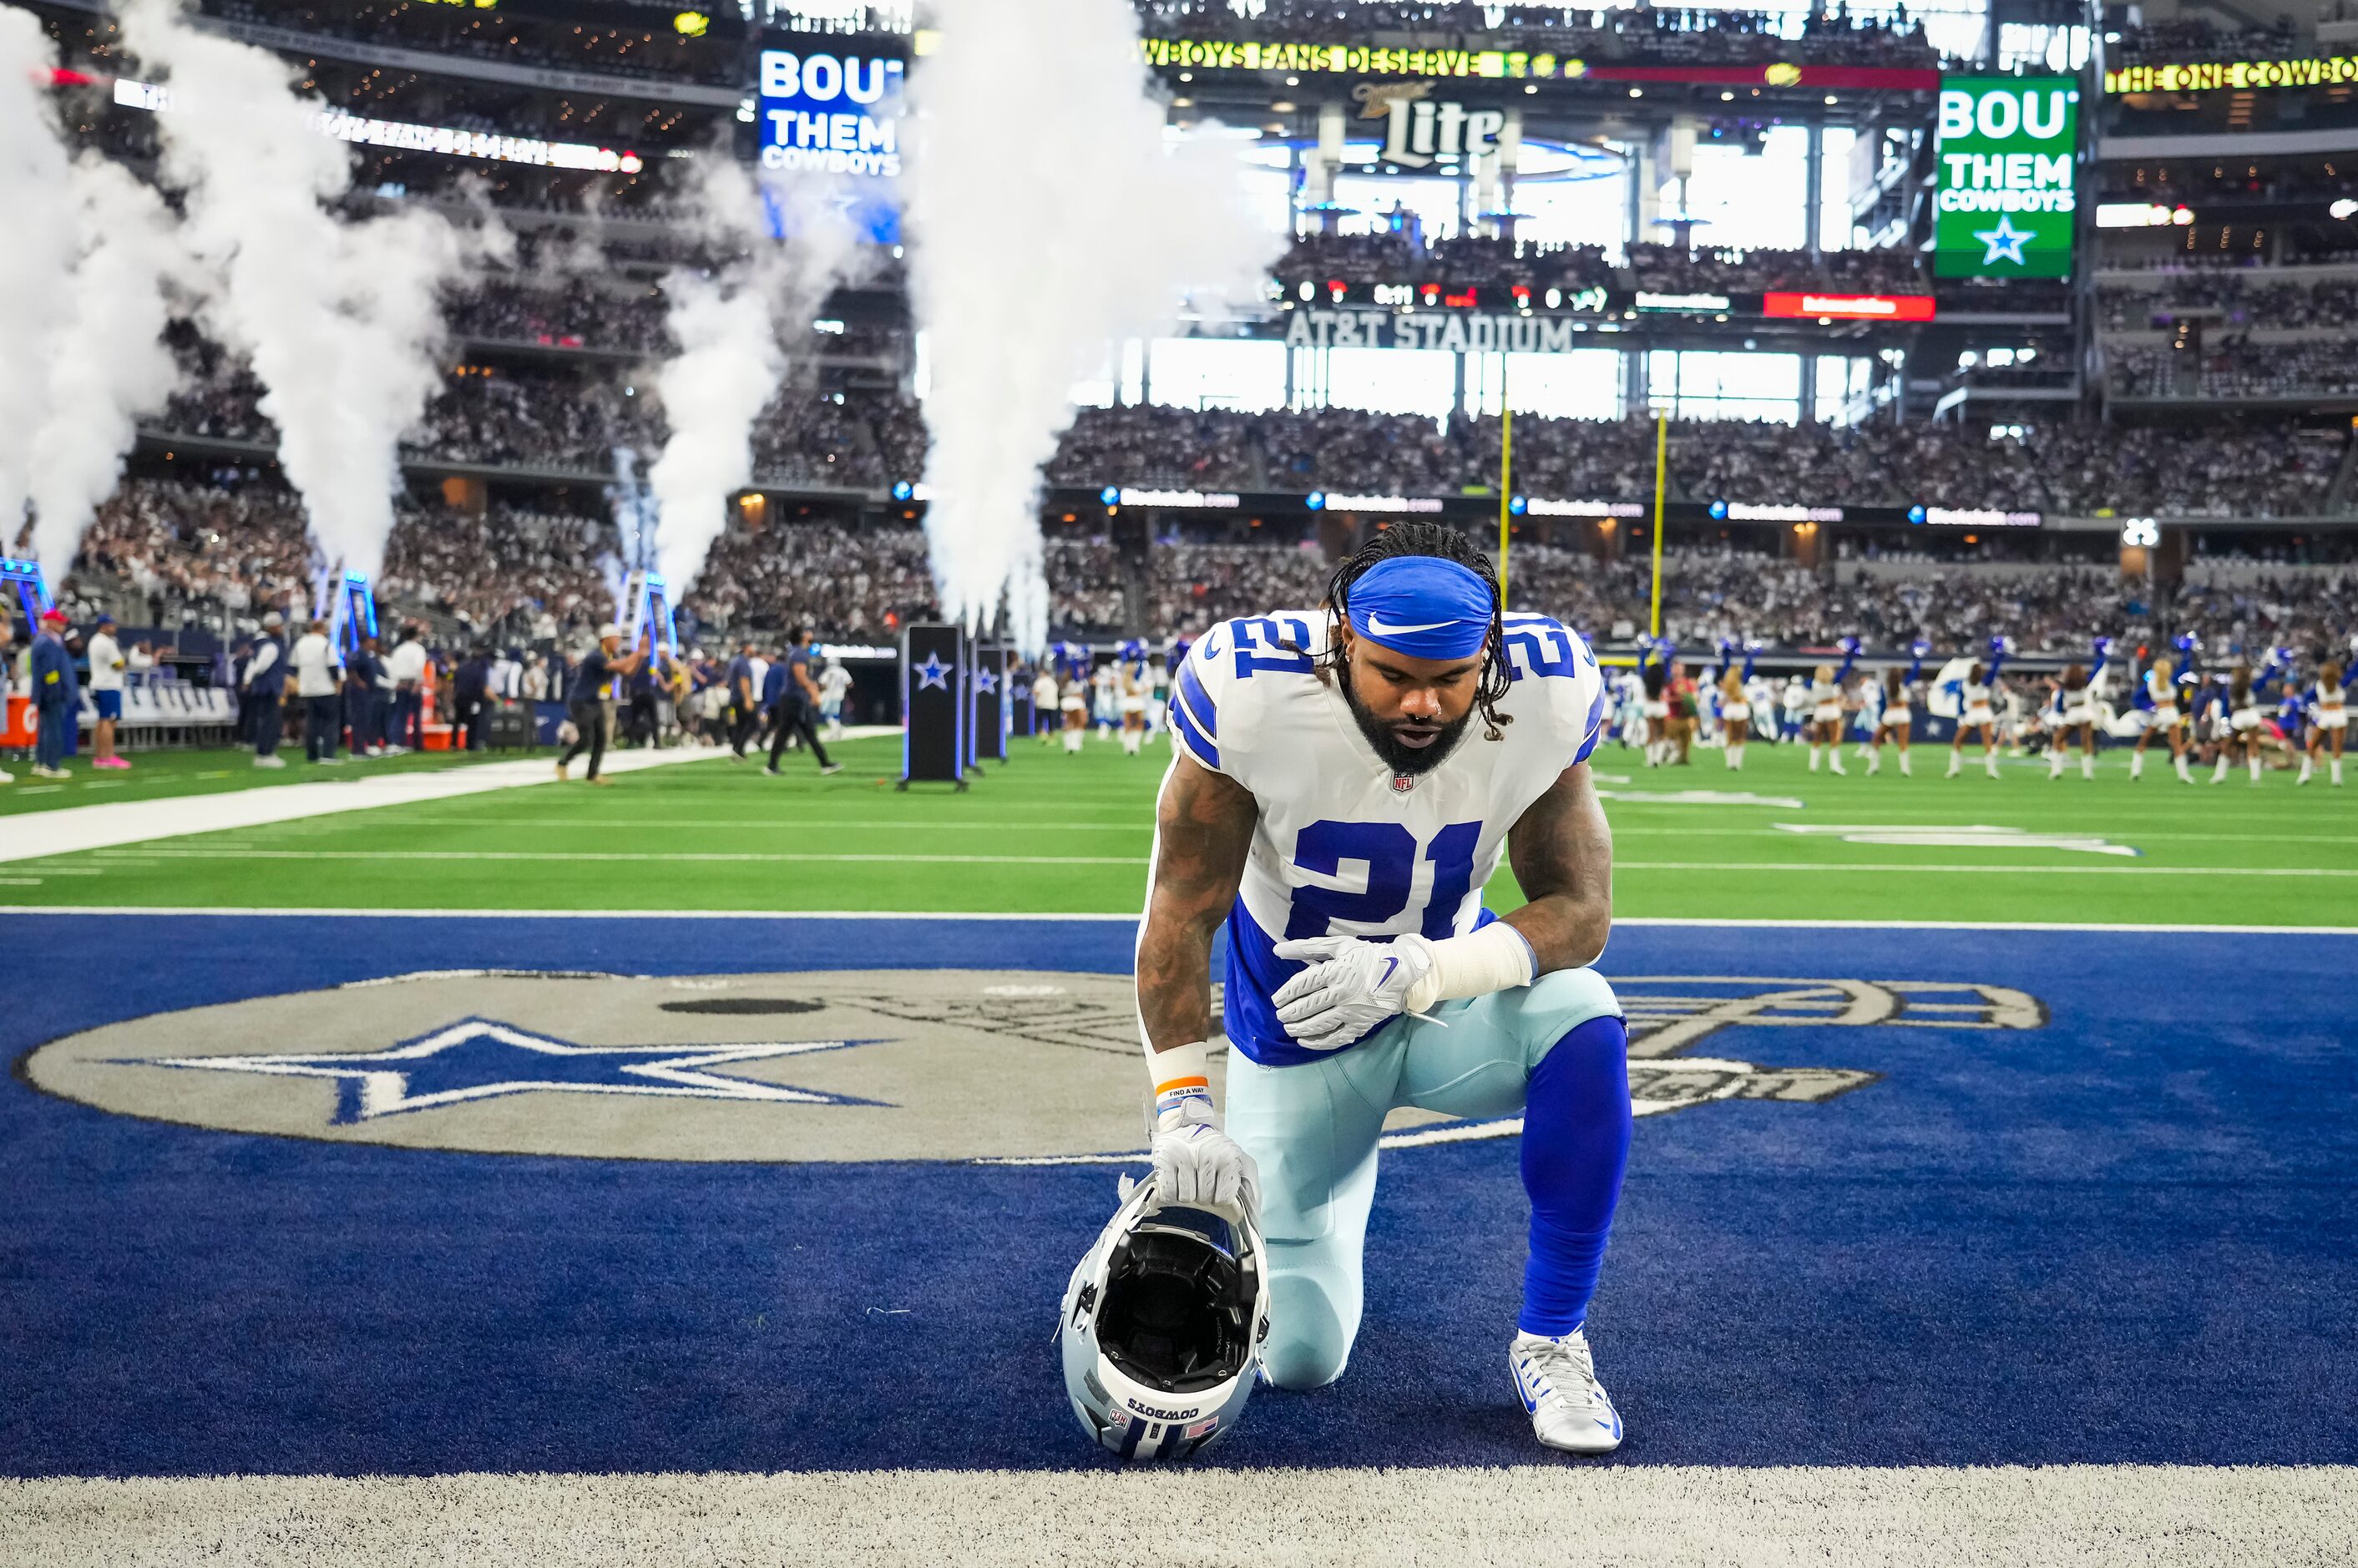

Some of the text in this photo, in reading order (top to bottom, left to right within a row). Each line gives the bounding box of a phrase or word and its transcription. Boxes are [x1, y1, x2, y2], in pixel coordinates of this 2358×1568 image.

[1259, 43, 1331, 72] FANS
[1346, 46, 1480, 77] DESERVE
[2105, 65, 2163, 93] THE
[2175, 63, 2233, 90] ONE
[767, 109, 896, 153] THEM
[1381, 98, 1505, 169] Lite
[762, 144, 902, 177] COWBOYS
[1943, 154, 2072, 190] THEM
[1939, 189, 2076, 212] COWBOYS
[1286, 310, 1573, 353] AT&T STADIUM
[1230, 617, 1315, 680] 21
[1395, 778, 1412, 789] NFL
[1284, 820, 1483, 942] 21
[1127, 1398, 1199, 1420] COWBOYS
